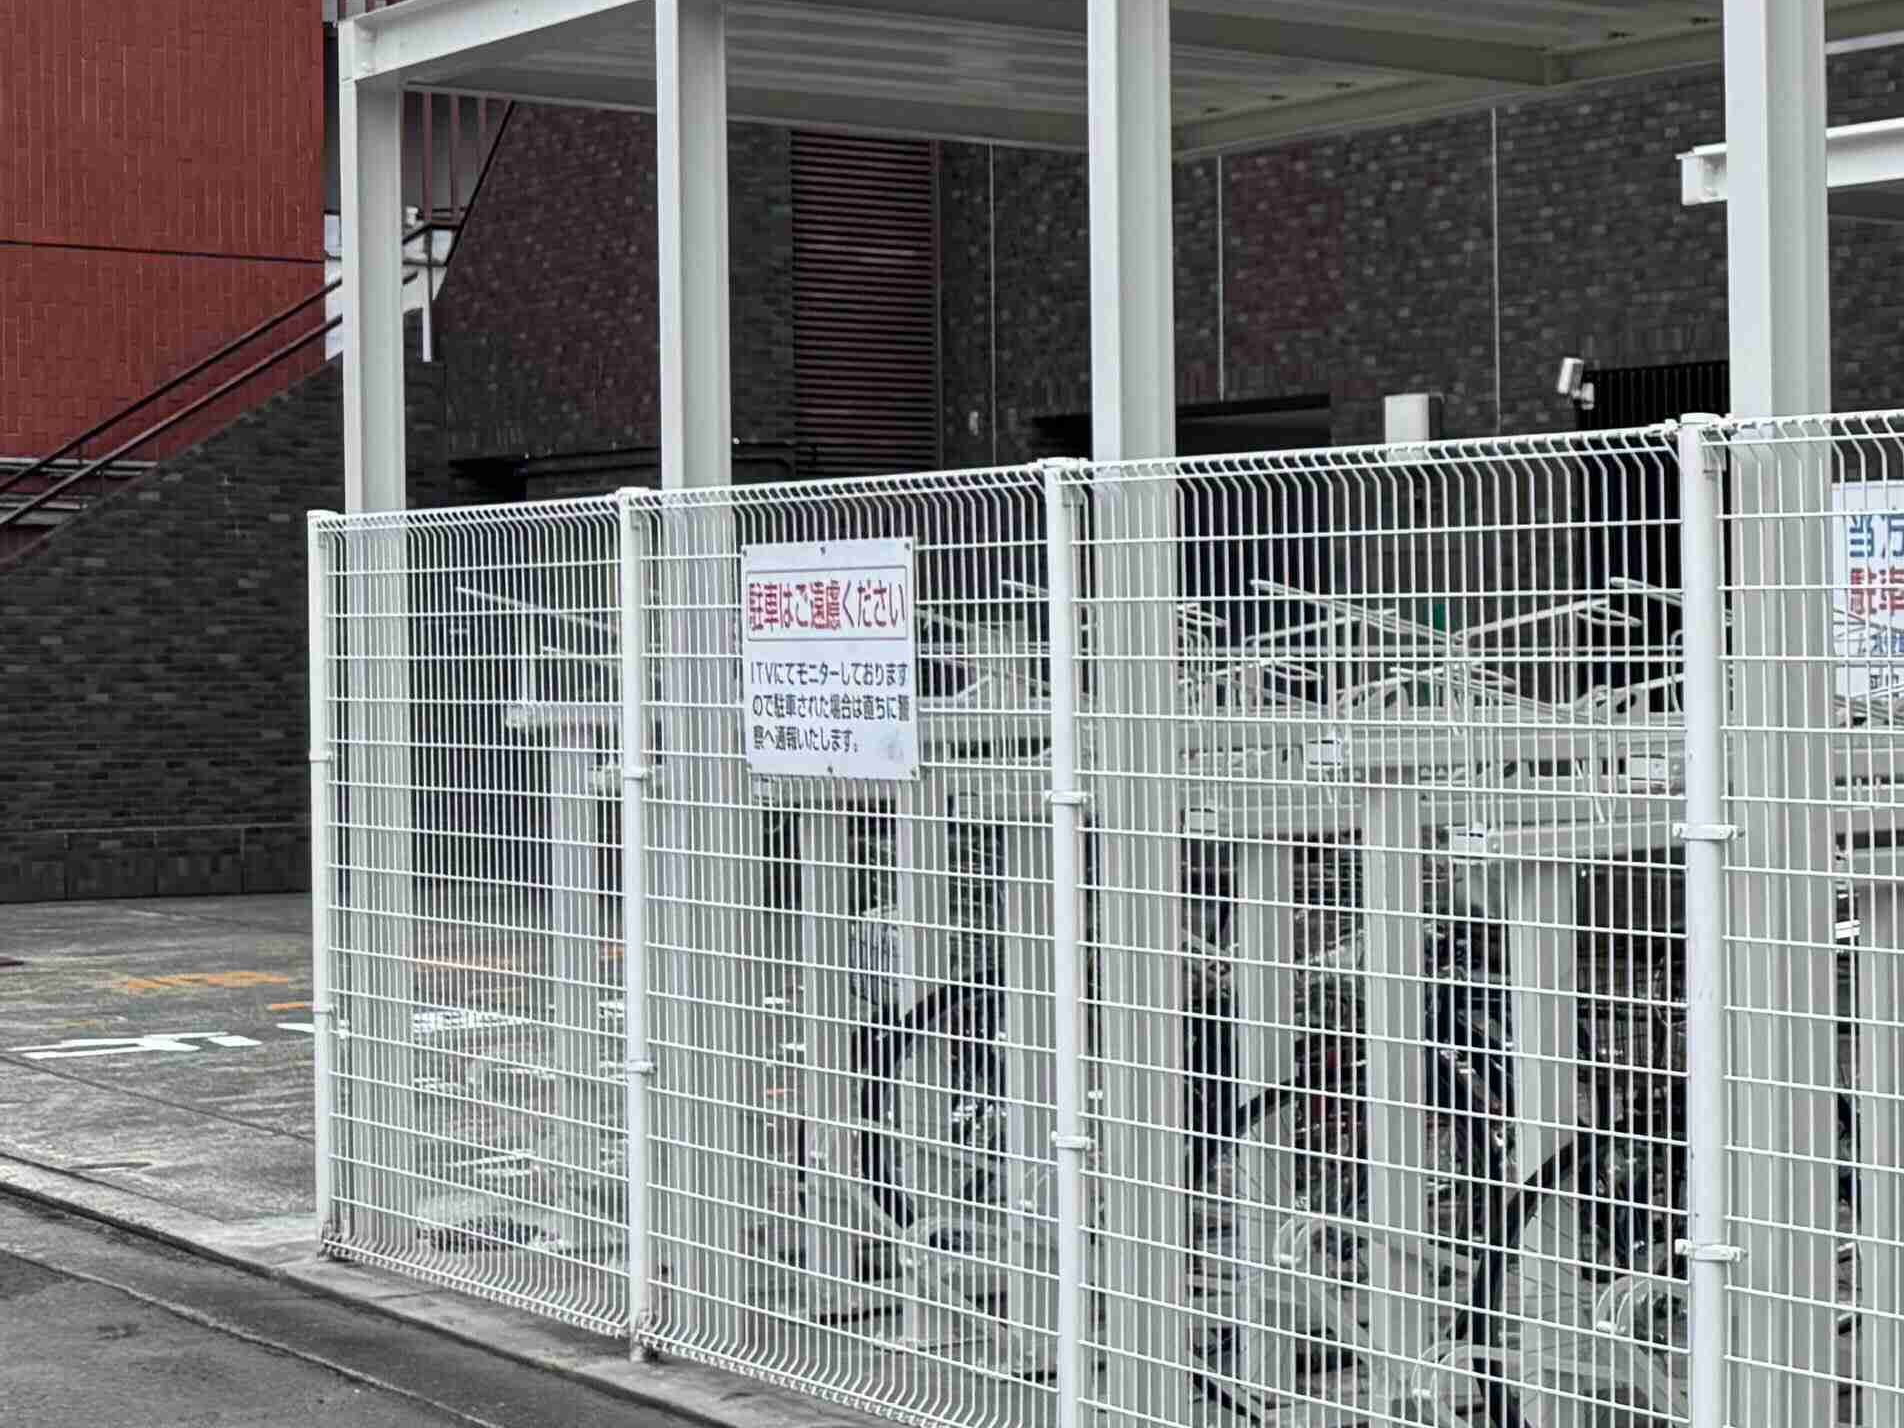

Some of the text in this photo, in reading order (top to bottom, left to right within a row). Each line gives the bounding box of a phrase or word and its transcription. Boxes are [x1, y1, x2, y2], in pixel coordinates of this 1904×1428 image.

[748, 578, 906, 632] 駐車はご遠慮ください
